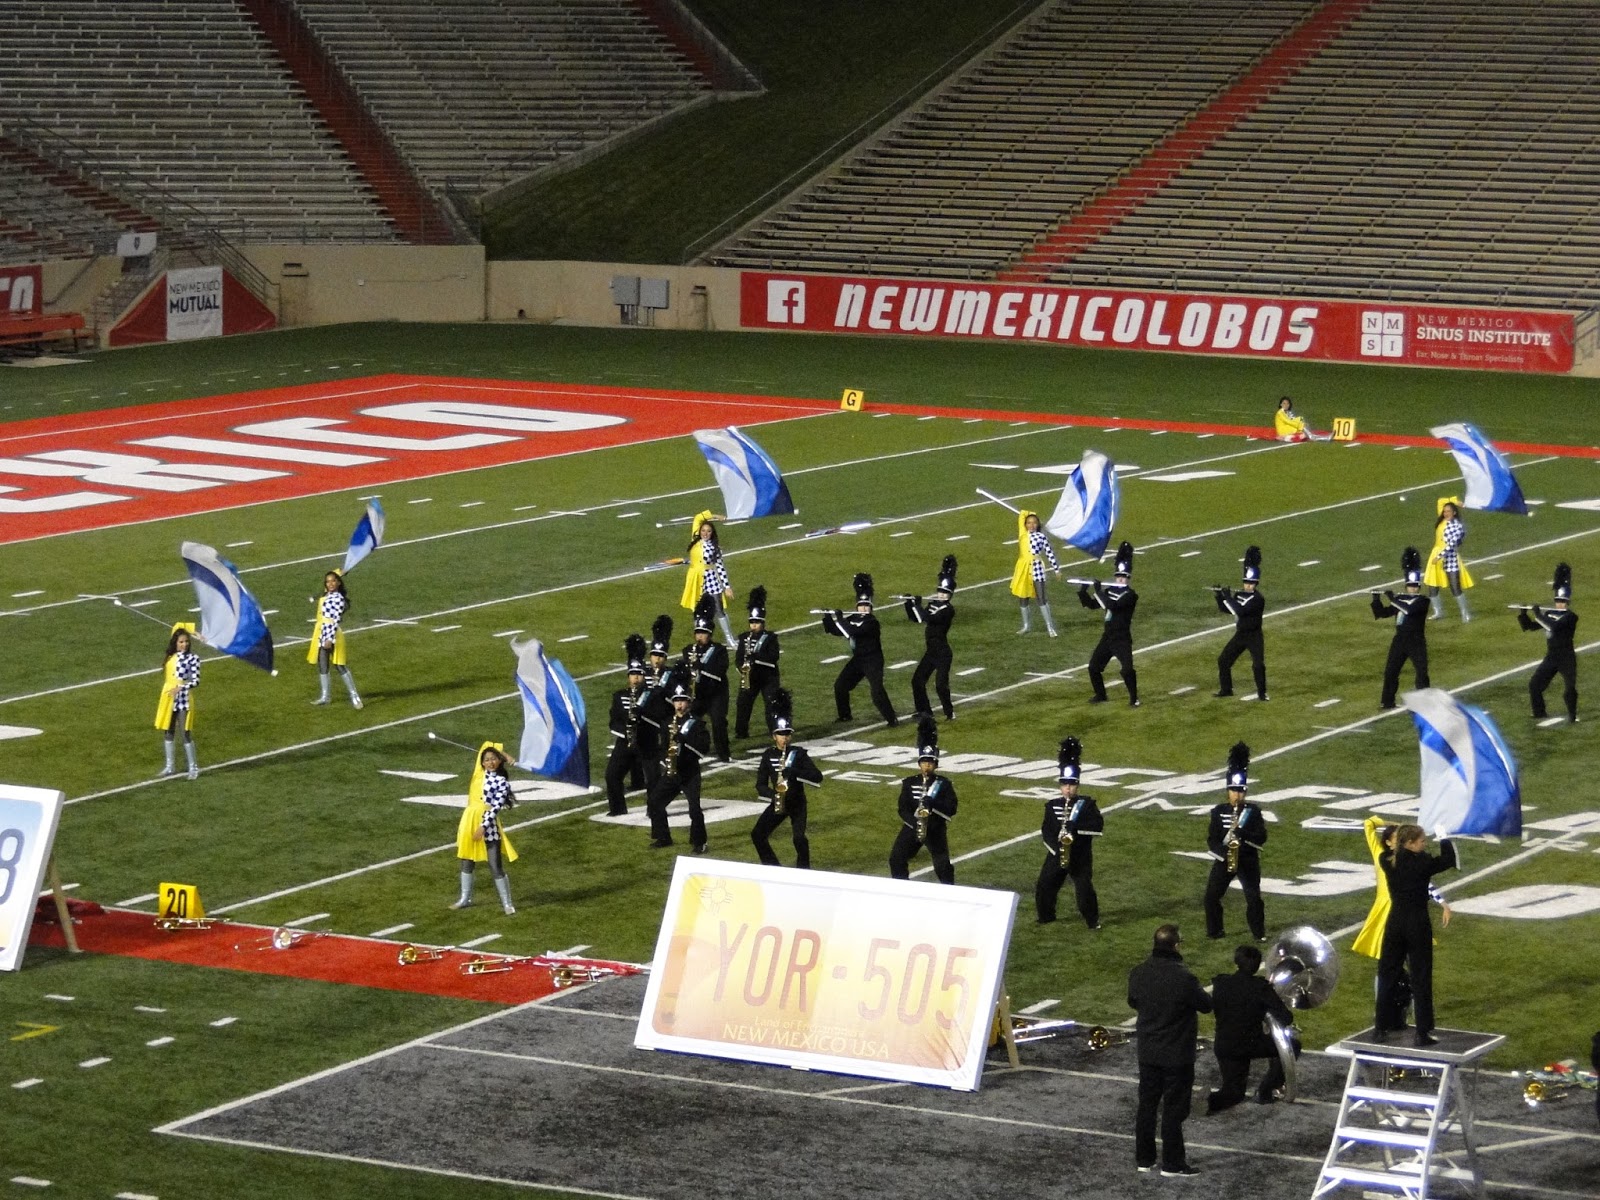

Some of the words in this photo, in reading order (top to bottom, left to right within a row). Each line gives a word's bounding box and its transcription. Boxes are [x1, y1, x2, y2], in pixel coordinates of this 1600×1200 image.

[169, 283, 188, 295] NEW
[190, 279, 220, 293] MEXICO
[169, 294, 220, 314] MUTUAL
[1417, 314, 1448, 325] NEW
[1457, 316, 1514, 328] MEXICO
[1416, 327, 1464, 342] SINUS
[1468, 329, 1551, 347] INSTITUTE
[846, 391, 857, 407] G
[1336, 420, 1351, 437] 10
[165, 887, 187, 918] 20
[713, 920, 821, 1013] YOR
[858, 937, 978, 1030] 505
[754, 1015, 780, 1027] Land
[783, 1019, 796, 1030] of
[722, 1022, 768, 1044] NEW
[771, 1029, 846, 1053] MEXICO
[852, 1038, 889, 1059] USA
